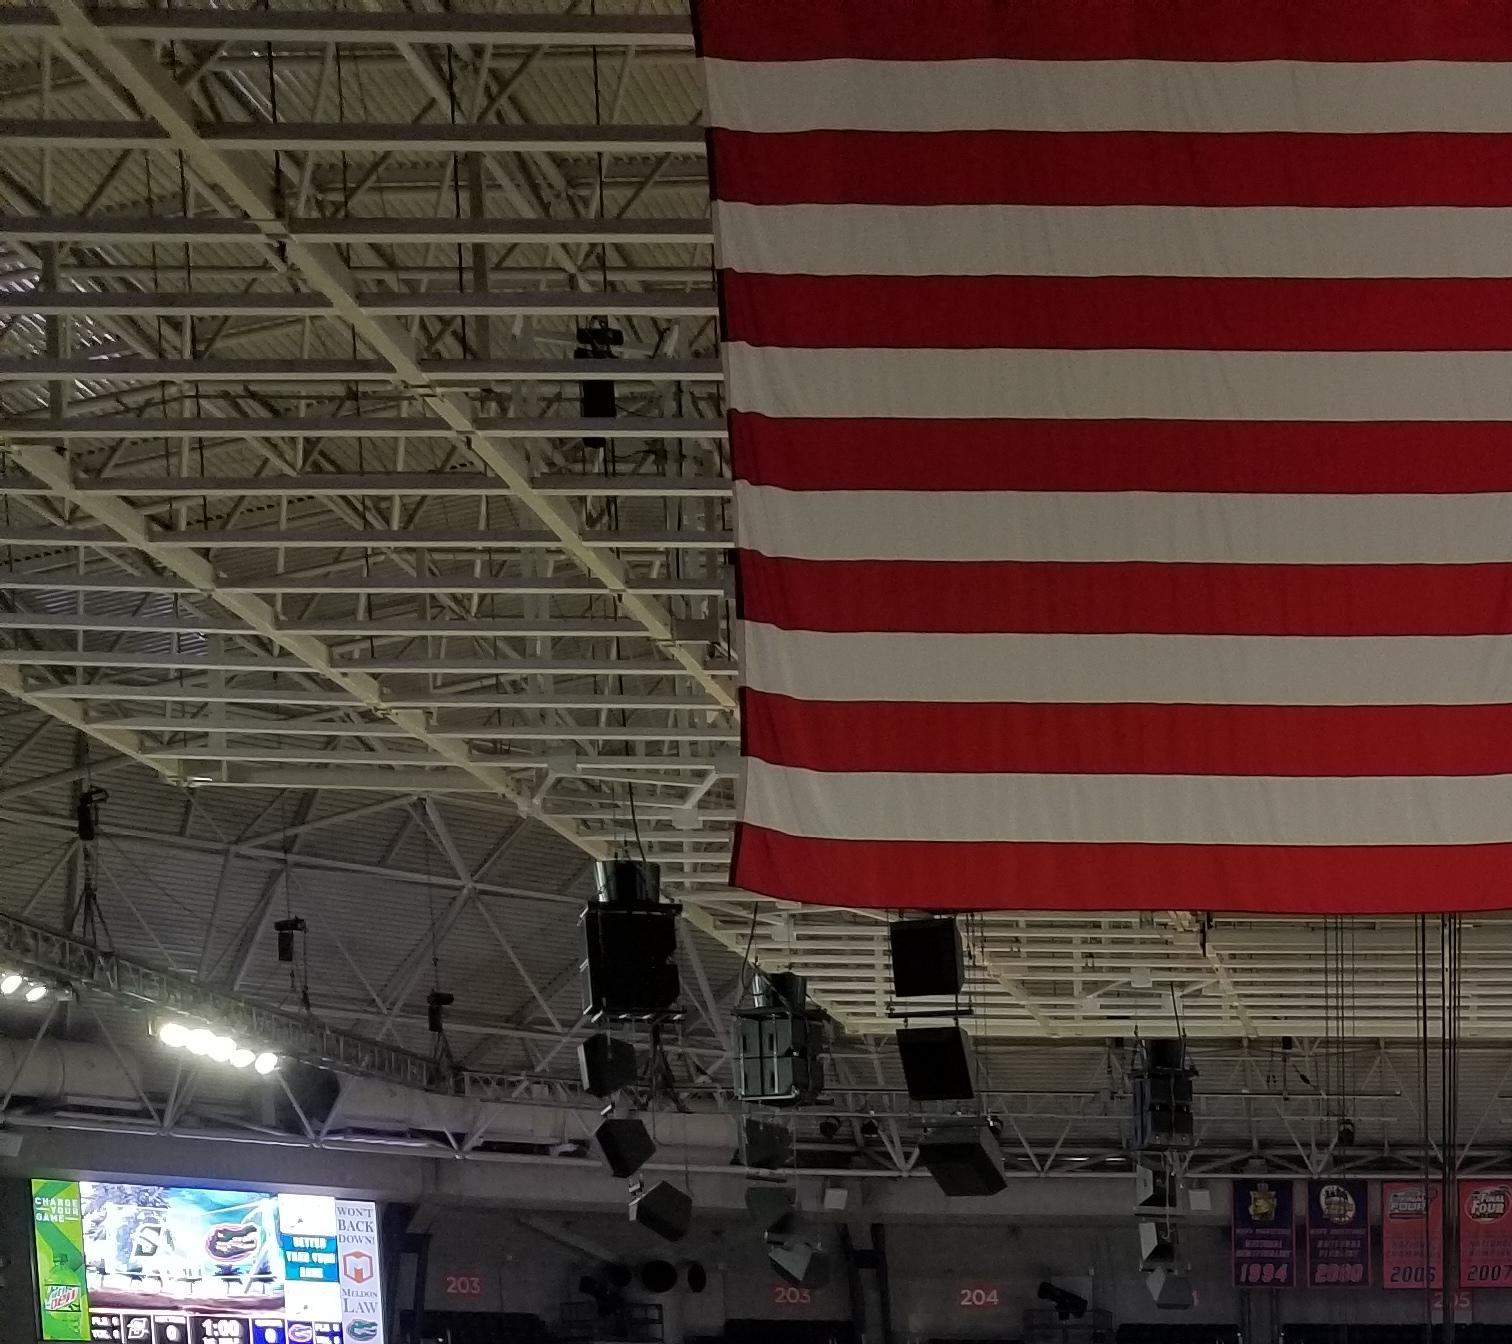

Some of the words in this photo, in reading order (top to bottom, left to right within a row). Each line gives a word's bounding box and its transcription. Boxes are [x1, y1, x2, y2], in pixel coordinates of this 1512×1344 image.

[336, 1206, 373, 1218] WON'T
[1471, 1202, 1505, 1214] FOUR
[338, 1219, 374, 1233] BACK
[1239, 1263, 1288, 1283] 1994
[1467, 1264, 1512, 1281] 2007
[445, 1276, 481, 1295] 203
[774, 1287, 811, 1305] 203
[960, 1288, 999, 1306] 204
[202, 1318, 240, 1337] 1:00
